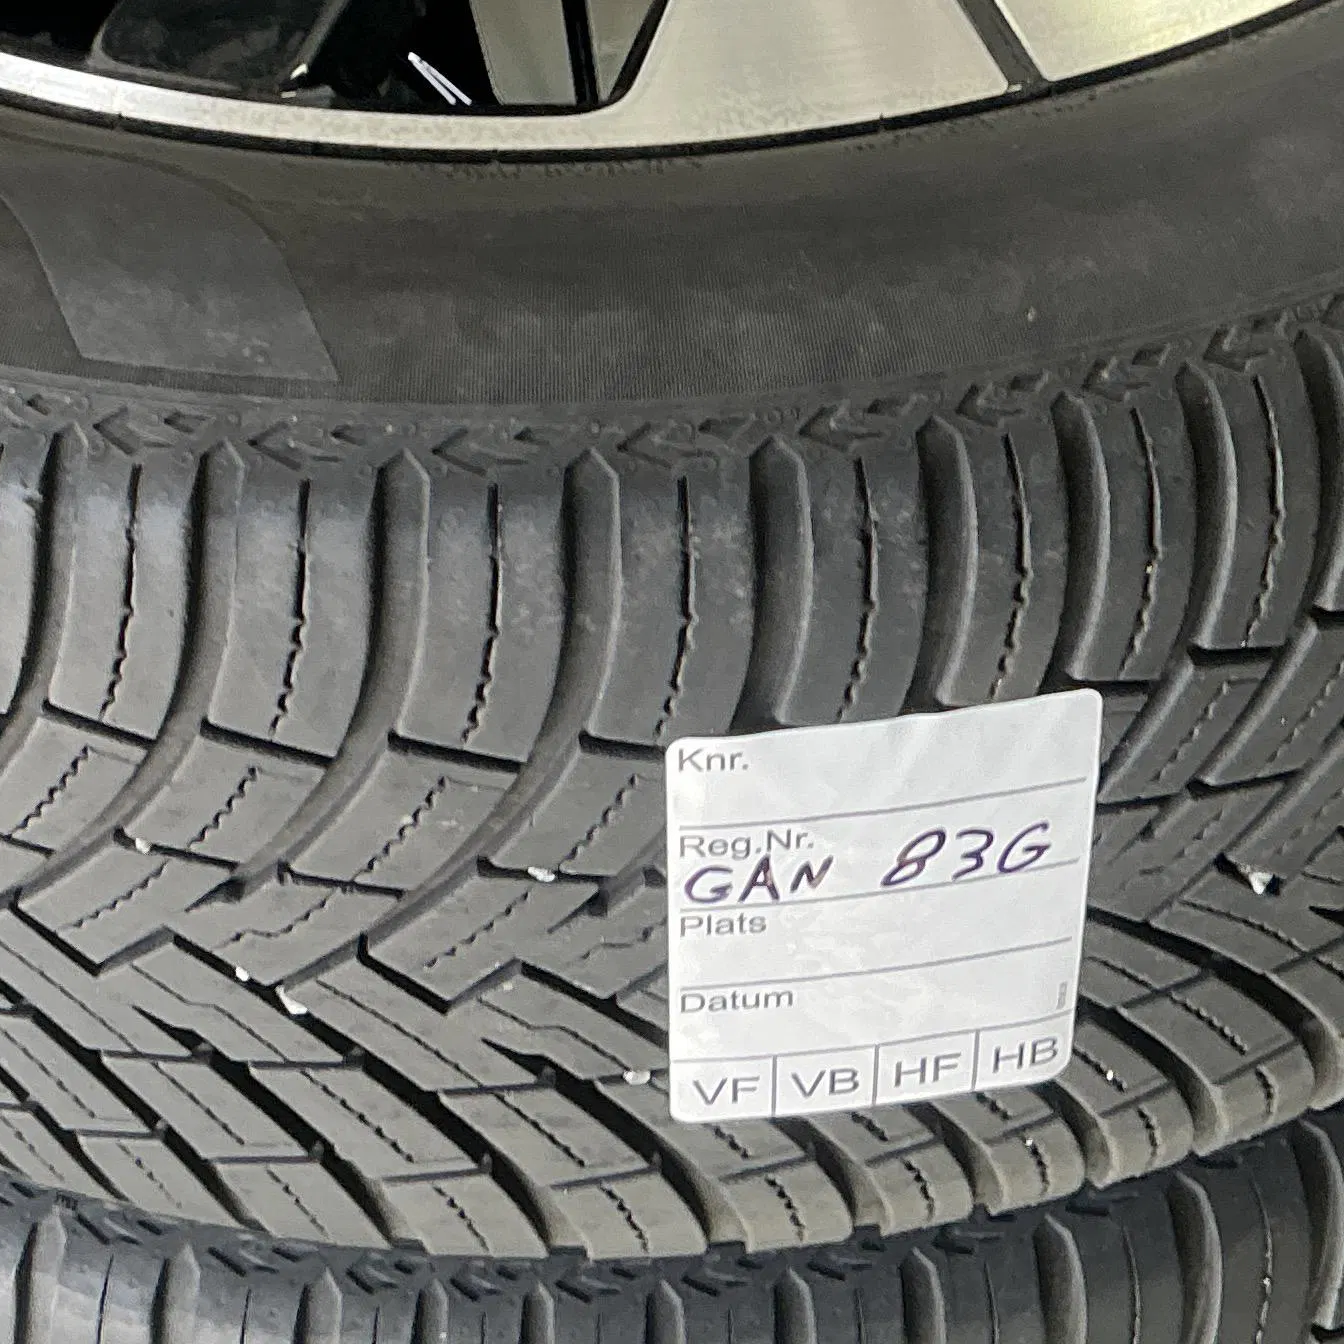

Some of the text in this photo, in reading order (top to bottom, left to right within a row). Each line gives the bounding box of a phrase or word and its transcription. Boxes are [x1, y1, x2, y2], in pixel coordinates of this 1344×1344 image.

[677, 748, 750, 773] Knr.
[679, 827, 816, 860] Reg.Nr.
[683, 855, 835, 904] GAN
[679, 912, 768, 938] Plats
[680, 986, 795, 1014] Datum
[692, 1035, 1060, 1107] VF VB HF HB
